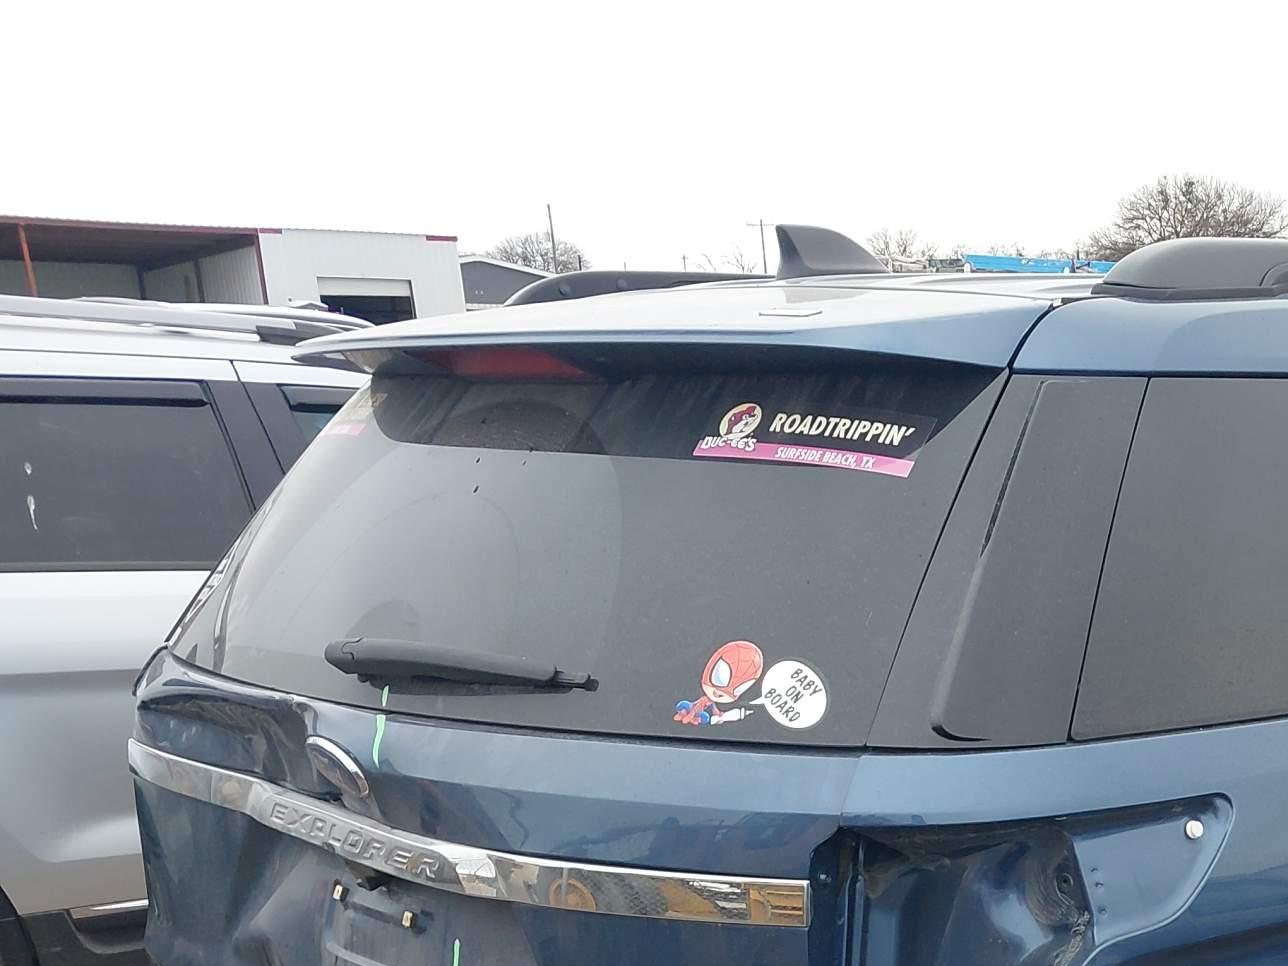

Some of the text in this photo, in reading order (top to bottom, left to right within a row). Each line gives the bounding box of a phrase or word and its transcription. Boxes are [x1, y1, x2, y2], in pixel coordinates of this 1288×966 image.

[769, 413, 916, 446] ROADTRIPPIN'
[775, 446, 876, 469] SURFSIDE BEACH, TX
[785, 686, 804, 705] ON
[790, 668, 823, 697] BABY
[764, 688, 801, 723] BOARD
[269, 801, 440, 879] EXPLORER
